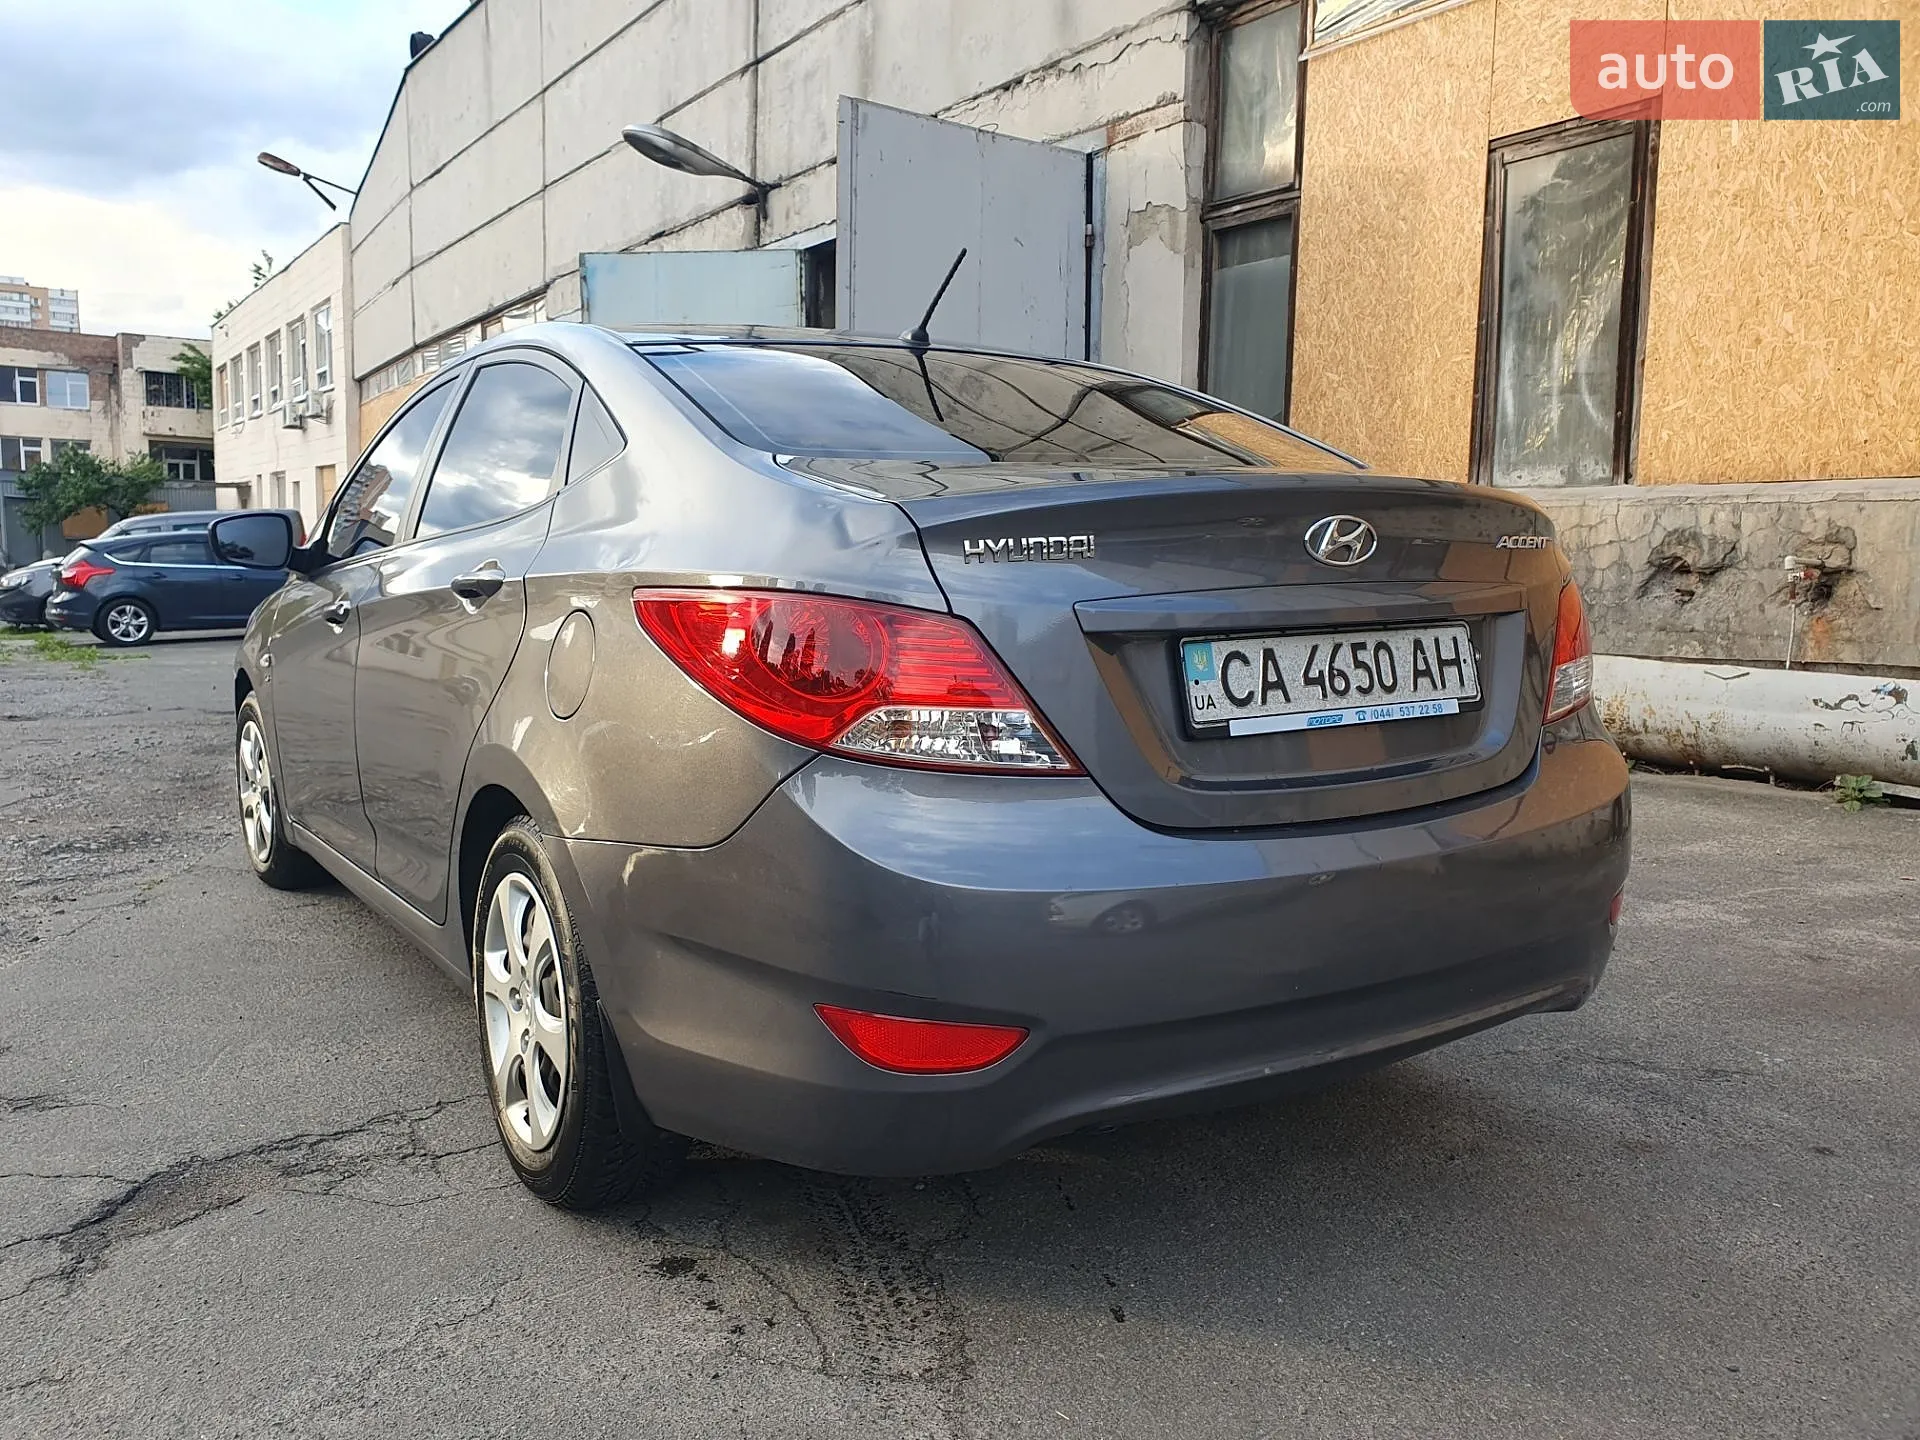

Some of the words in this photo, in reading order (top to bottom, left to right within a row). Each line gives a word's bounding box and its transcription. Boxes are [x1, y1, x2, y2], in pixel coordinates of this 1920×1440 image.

[963, 535, 1096, 564] HYUNDAI
[1495, 535, 1552, 549] ACCENT
[1220, 648, 1291, 708] CA
[1301, 640, 1398, 700] 4650
[1411, 636, 1465, 692] AH
[1194, 694, 1217, 710] UA
[1399, 705, 1415, 717] 537
[1419, 704, 1431, 715] 22
[1432, 703, 1443, 713] 58
